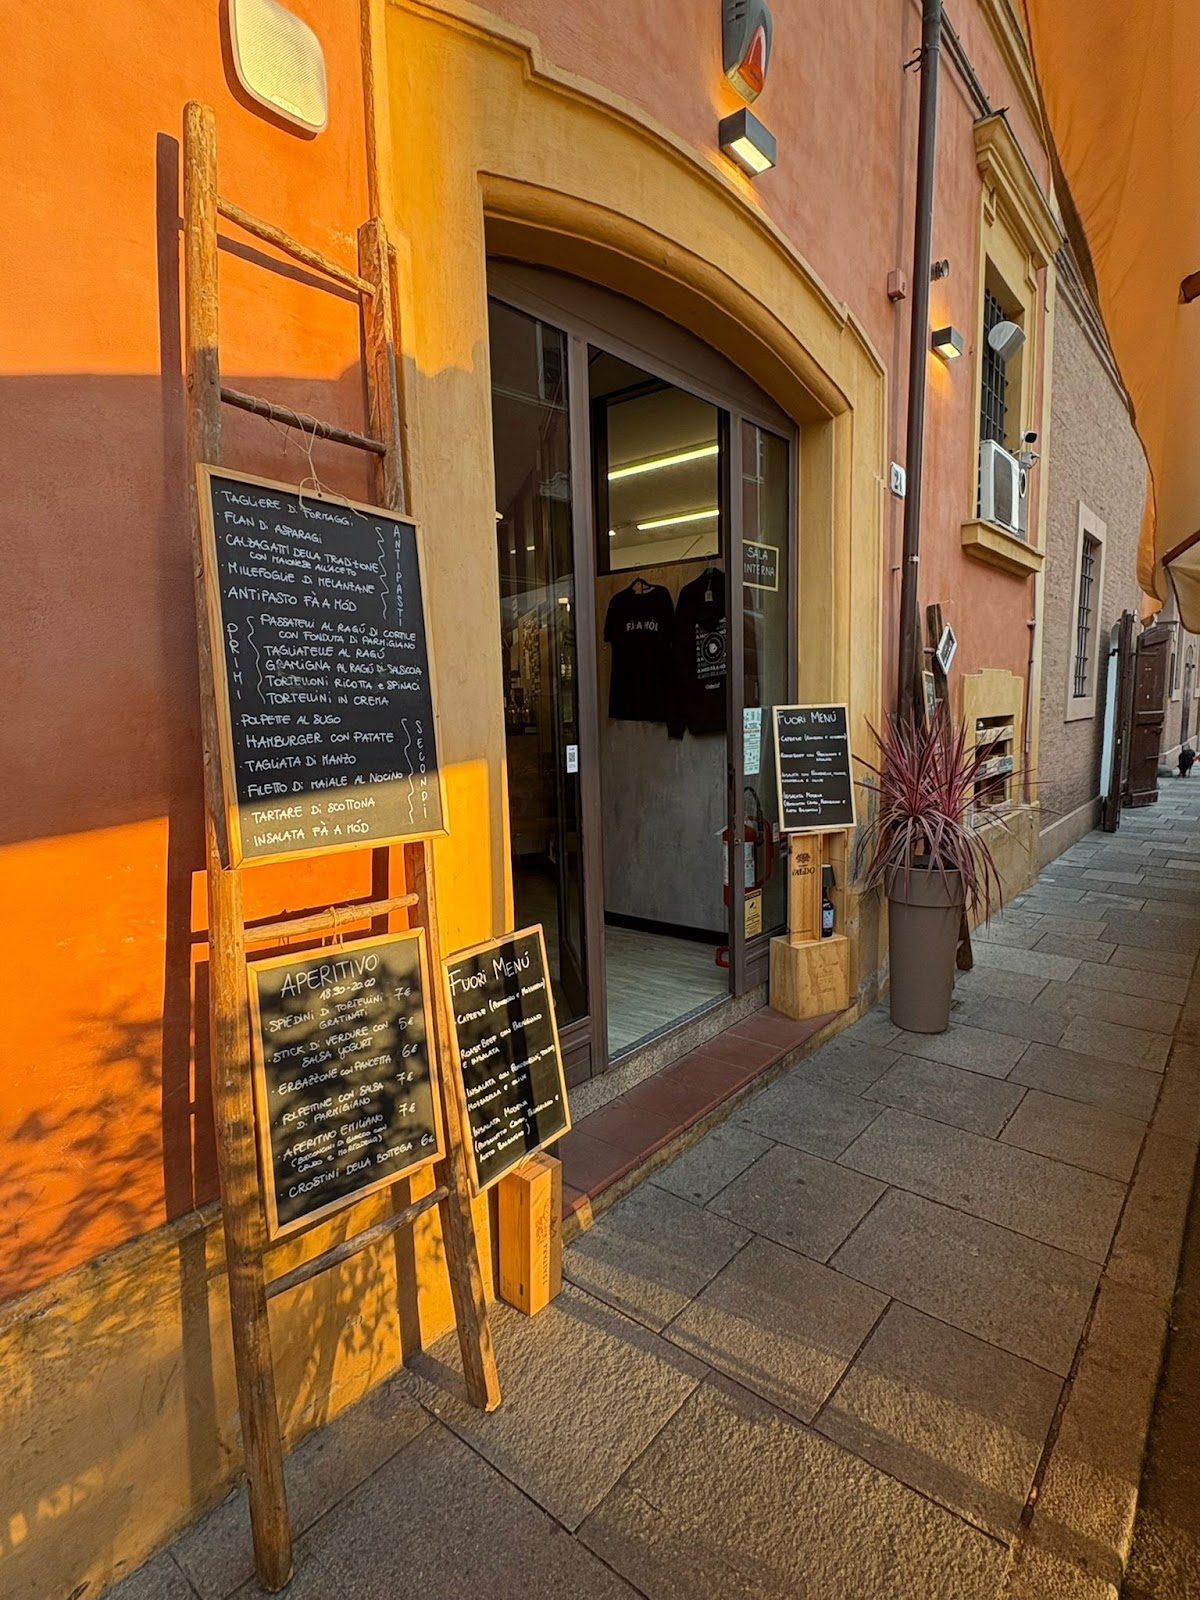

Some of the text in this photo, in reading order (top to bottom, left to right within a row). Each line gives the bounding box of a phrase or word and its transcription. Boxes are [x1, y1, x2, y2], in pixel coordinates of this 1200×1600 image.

[224, 511, 255, 527] FLAN
[249, 551, 267, 561] CON
[293, 547, 321, 561] DELLA
[746, 546, 768, 560] SALA
[744, 563, 775, 577] INTERNA
[321, 622, 334, 632] AL
[278, 630, 299, 639] CON
[303, 631, 344, 644] FONDUTA
[338, 648, 351, 658] AL
[337, 663, 348, 673] AL
[338, 695, 348, 704] IN
[353, 696, 389, 706] CREMA
[241, 713, 341, 727] POLPETTE AL SUGO
[246, 732, 394, 748] HAMBURGER CON PATATE
[322, 753, 357, 766] MANZO
[247, 782, 288, 798] FILETTO
[354, 775, 365, 785] AL
[251, 806, 303, 824] TARTARE
[327, 797, 376, 814] SCOTTONA
[253, 828, 305, 847] INSALATA
[333, 825, 342, 835] A
[280, 953, 379, 998] APERITIVO
[273, 1045, 305, 1063] STICK
[326, 1026, 369, 1045] VERDURE
[373, 1021, 389, 1033] CON
[301, 1051, 332, 1068] SALSA
[278, 1068, 338, 1096] ERBAZZONE
[354, 1053, 392, 1071] PANCETTA
[338, 1089, 354, 1103] CON
[359, 1081, 384, 1096] SALSA
[346, 1159, 372, 1176] DELLA
[376, 1143, 413, 1164] BOTTEGA
